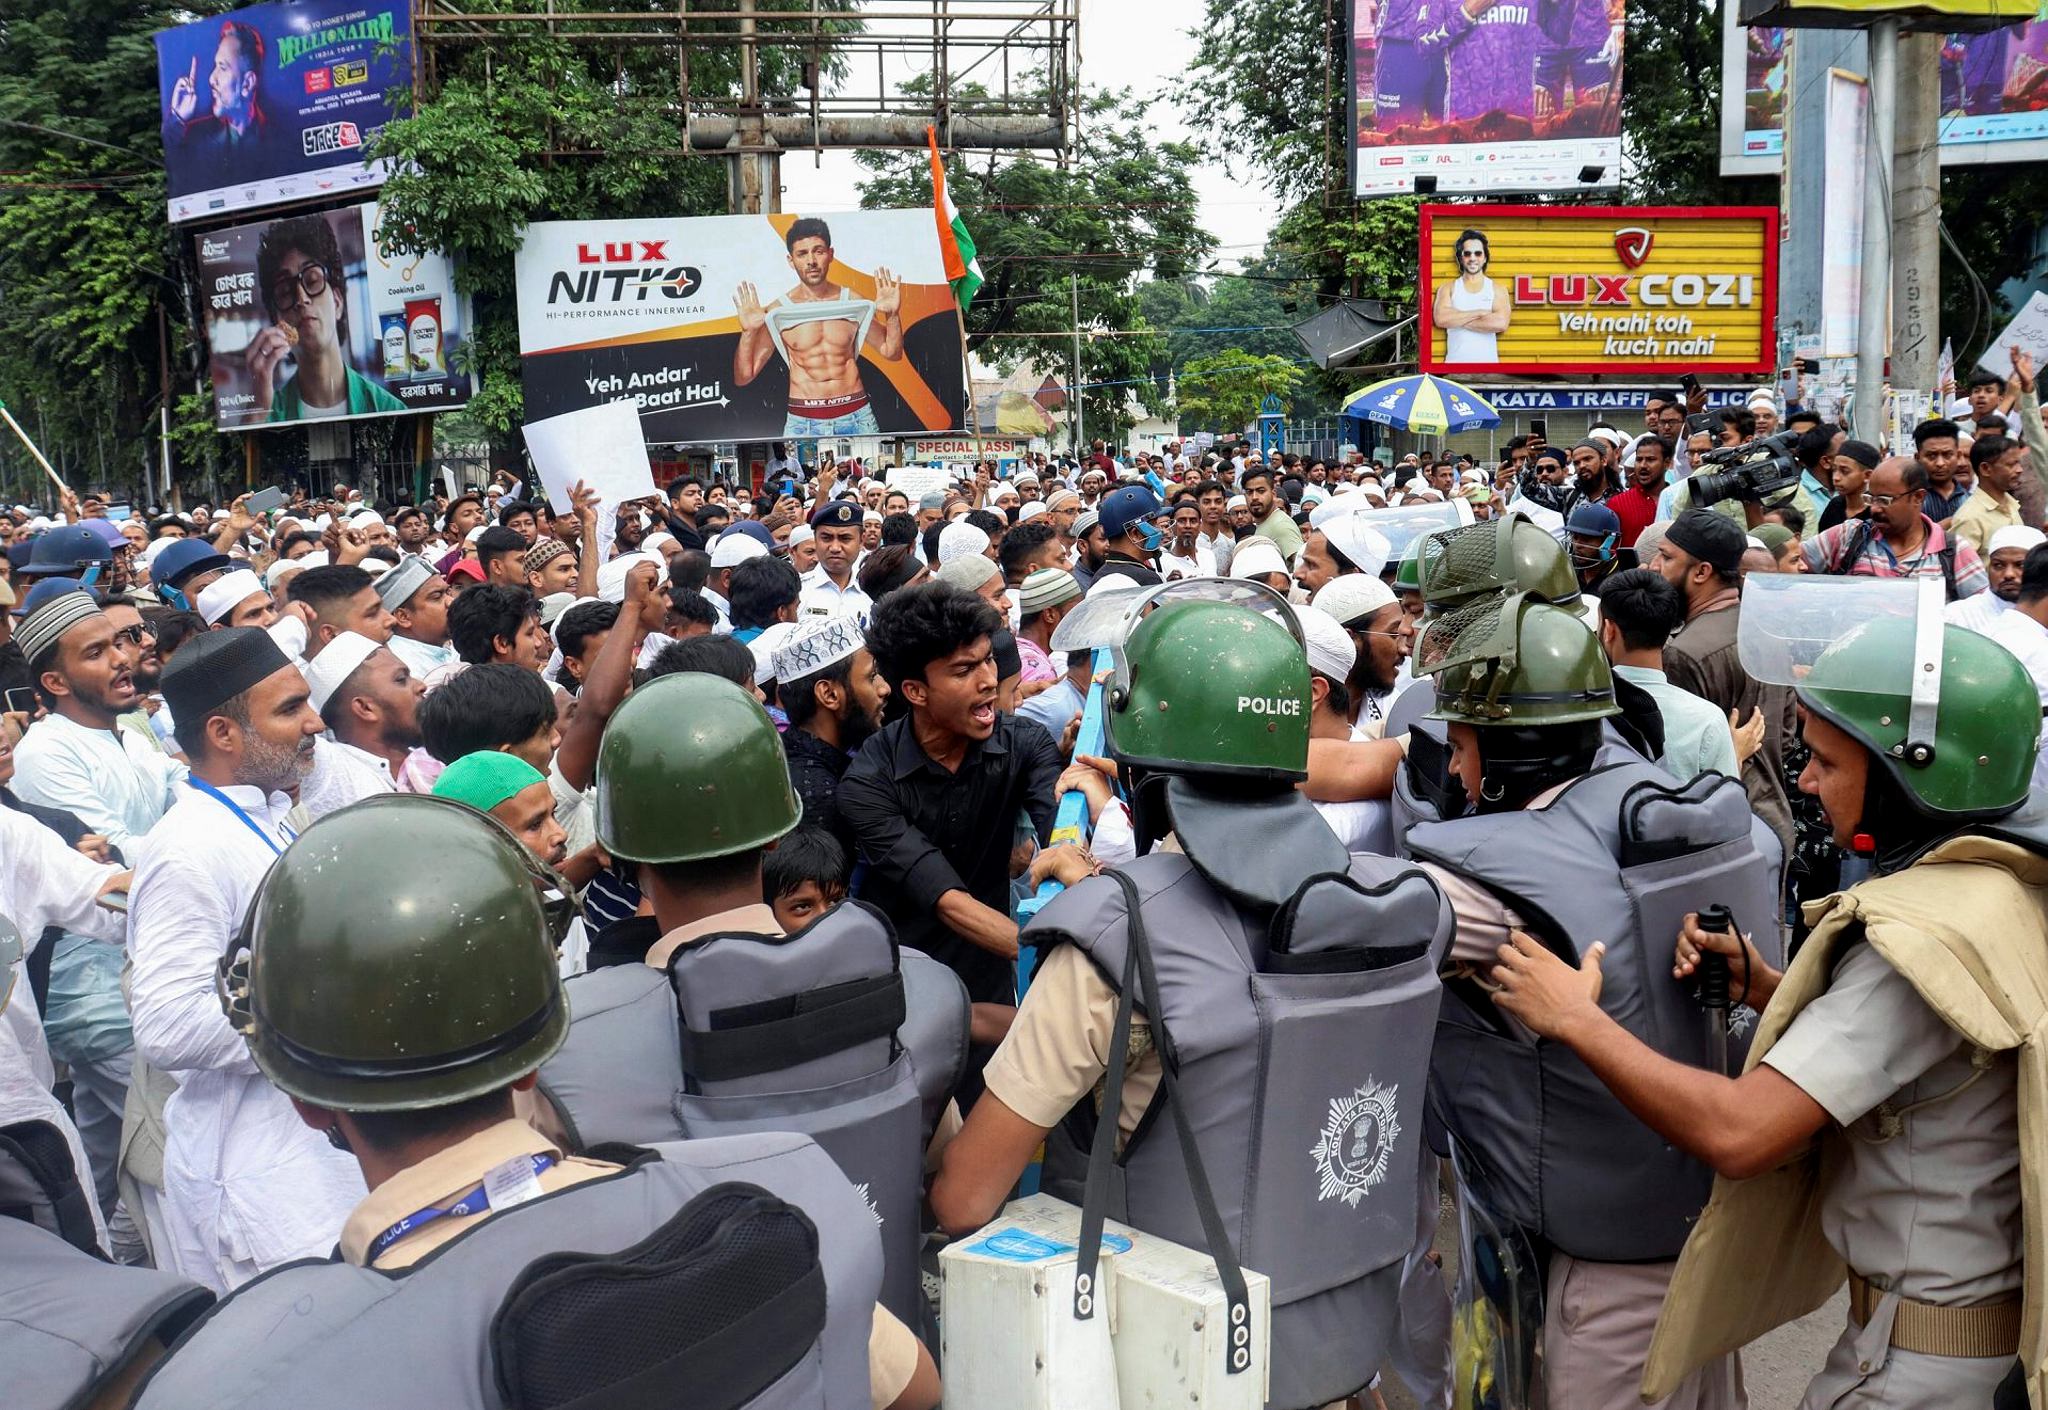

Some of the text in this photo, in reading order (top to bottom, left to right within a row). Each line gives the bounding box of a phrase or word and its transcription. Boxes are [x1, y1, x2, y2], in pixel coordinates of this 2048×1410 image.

[322, 16, 345, 26] HONEY
[345, 10, 367, 21] SINGH
[1472, 5, 1529, 26] EAM11
[277, 11, 393, 69] MILLIONAIRE
[315, 45, 355, 59] INDIA TOUR
[577, 239, 670, 264] LUX
[215, 273, 237, 293] চোখ
[388, 283, 426, 296] Cooking Oil
[1515, 274, 1753, 306] LUX COZI
[210, 290, 253, 309] করে খান
[546, 305, 706, 319] HI-PERFORMANCE INNERWEAR
[1558, 312, 1693, 334] Yeh nahi toh
[1604, 333, 1717, 356] kuch nahi
[585, 367, 692, 395] Yeh Andar
[400, 384, 427, 398] ভরসার
[634, 388, 682, 409] Baat
[686, 381, 720, 401] Hai
[1480, 391, 1556, 408] KATA
[1568, 391, 1649, 408] TRAFFI
[1370, 412, 1390, 423] DEAR
[917, 441, 1015, 453] SPECIAL ASSI
[1237, 696, 1300, 715] POLICE
[1331, 1101, 1387, 1157] KOLKATA POLICE FORCE
